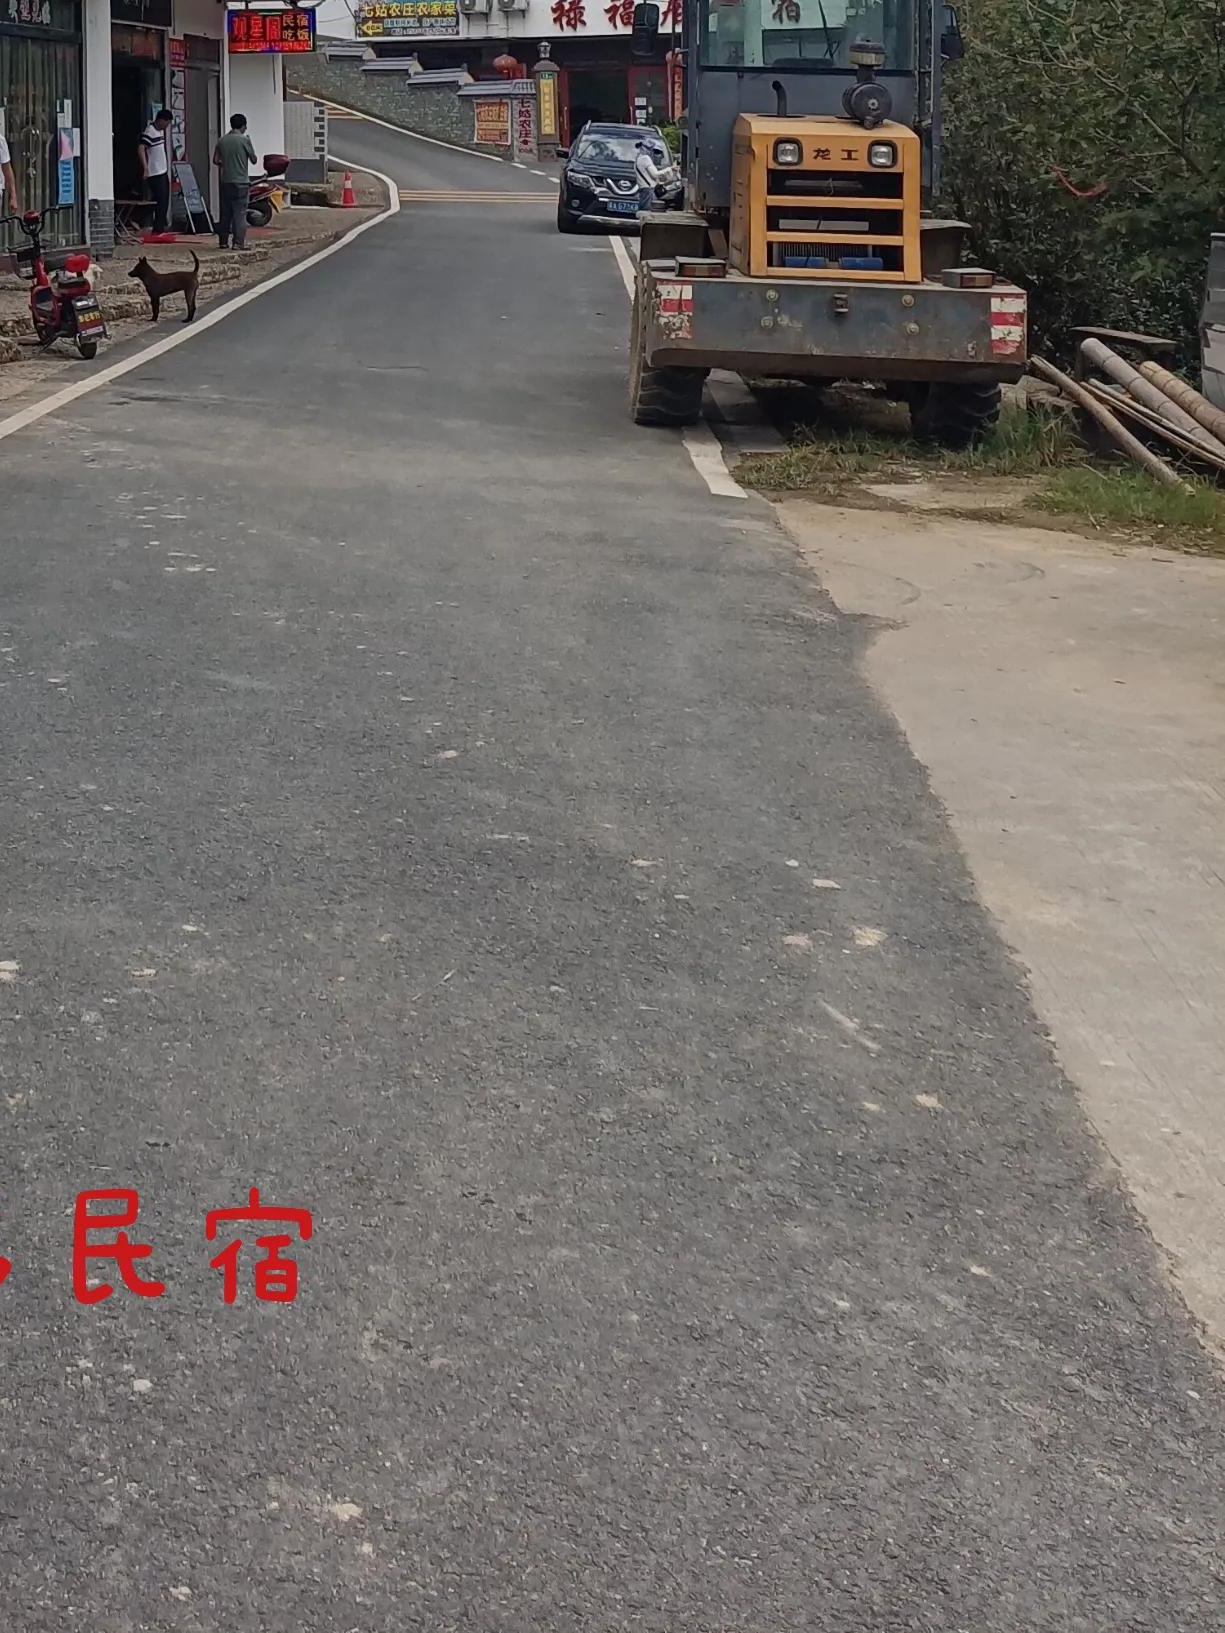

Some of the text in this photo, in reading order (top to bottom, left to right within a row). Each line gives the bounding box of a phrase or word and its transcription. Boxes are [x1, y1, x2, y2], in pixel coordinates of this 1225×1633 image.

[282, 14, 309, 27] 民宿
[282, 28, 309, 41] 吃饭
[812, 147, 859, 161] 龙工
